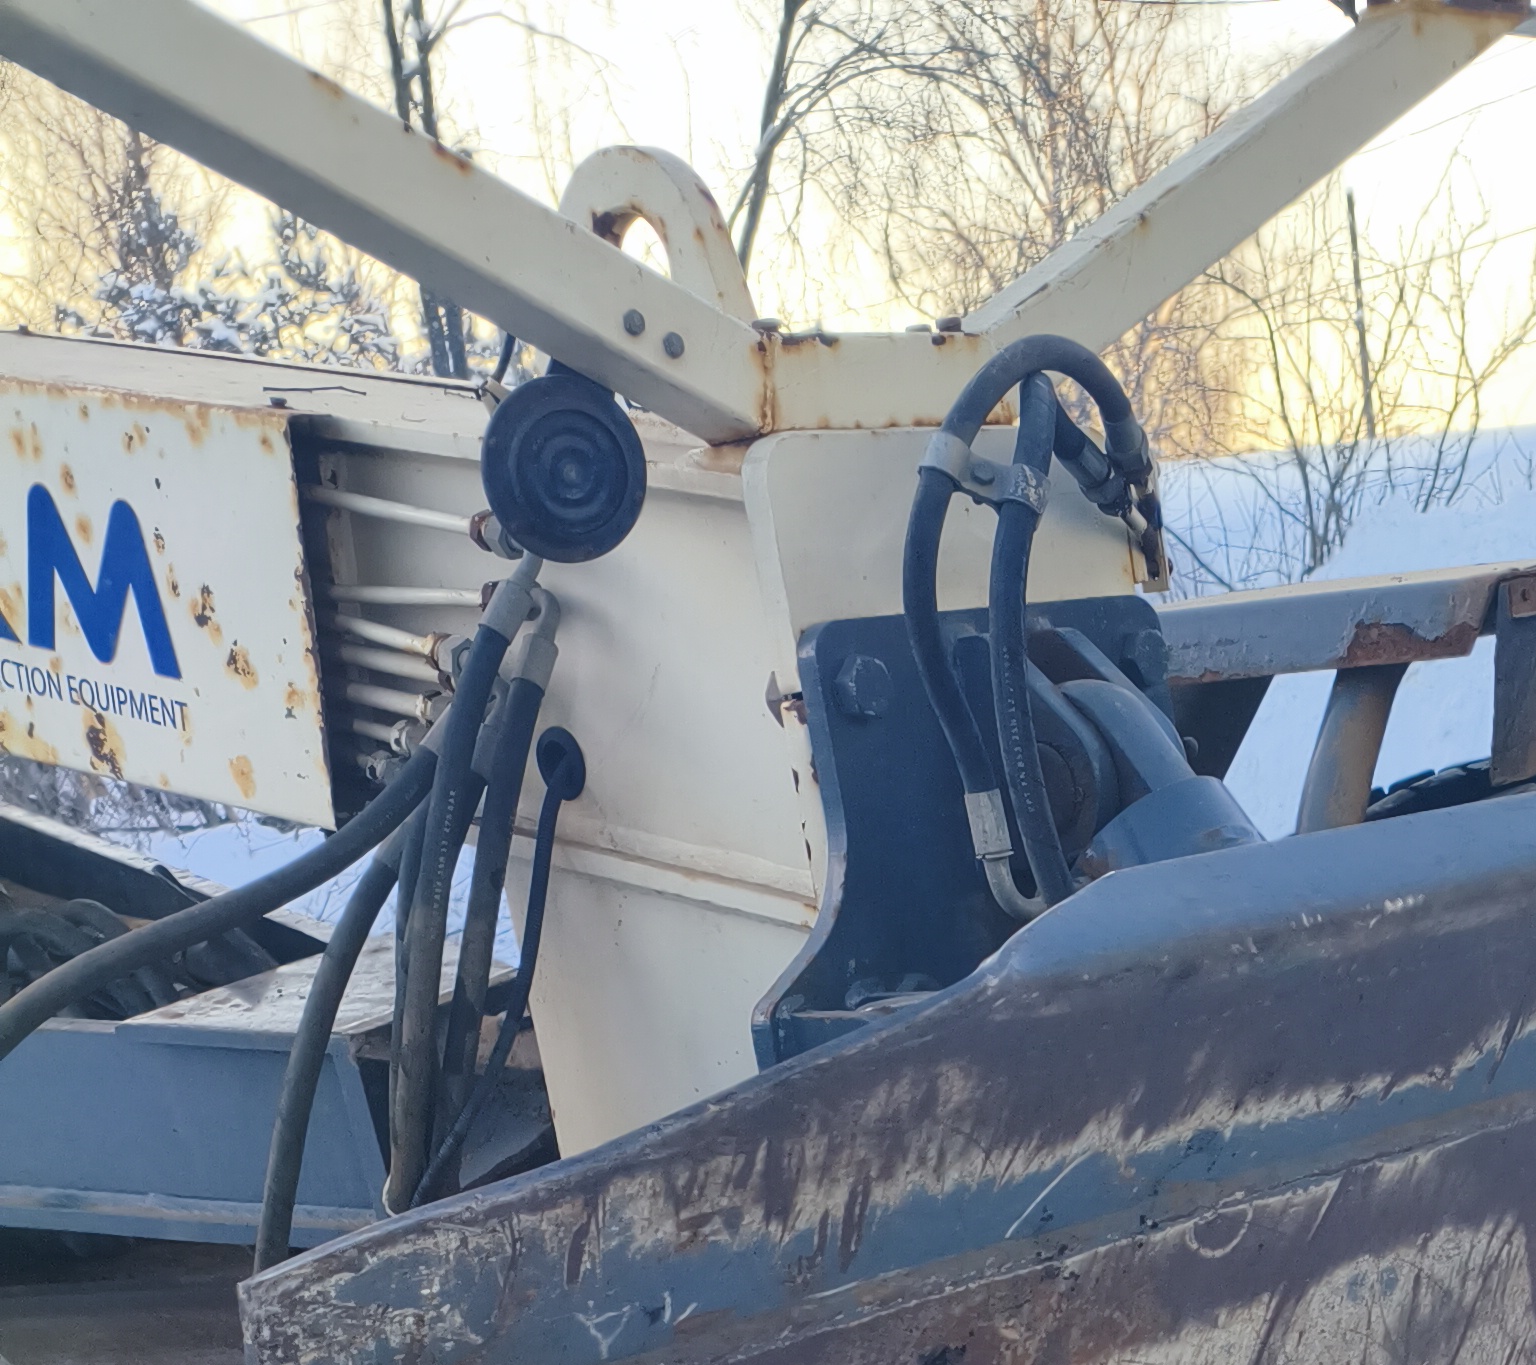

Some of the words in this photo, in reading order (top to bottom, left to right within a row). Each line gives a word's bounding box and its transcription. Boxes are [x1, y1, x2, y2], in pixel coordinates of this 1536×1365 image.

[0, 482, 182, 680] M
[1, 658, 64, 702] CTION
[66, 675, 187, 732] EQUIPMENT
